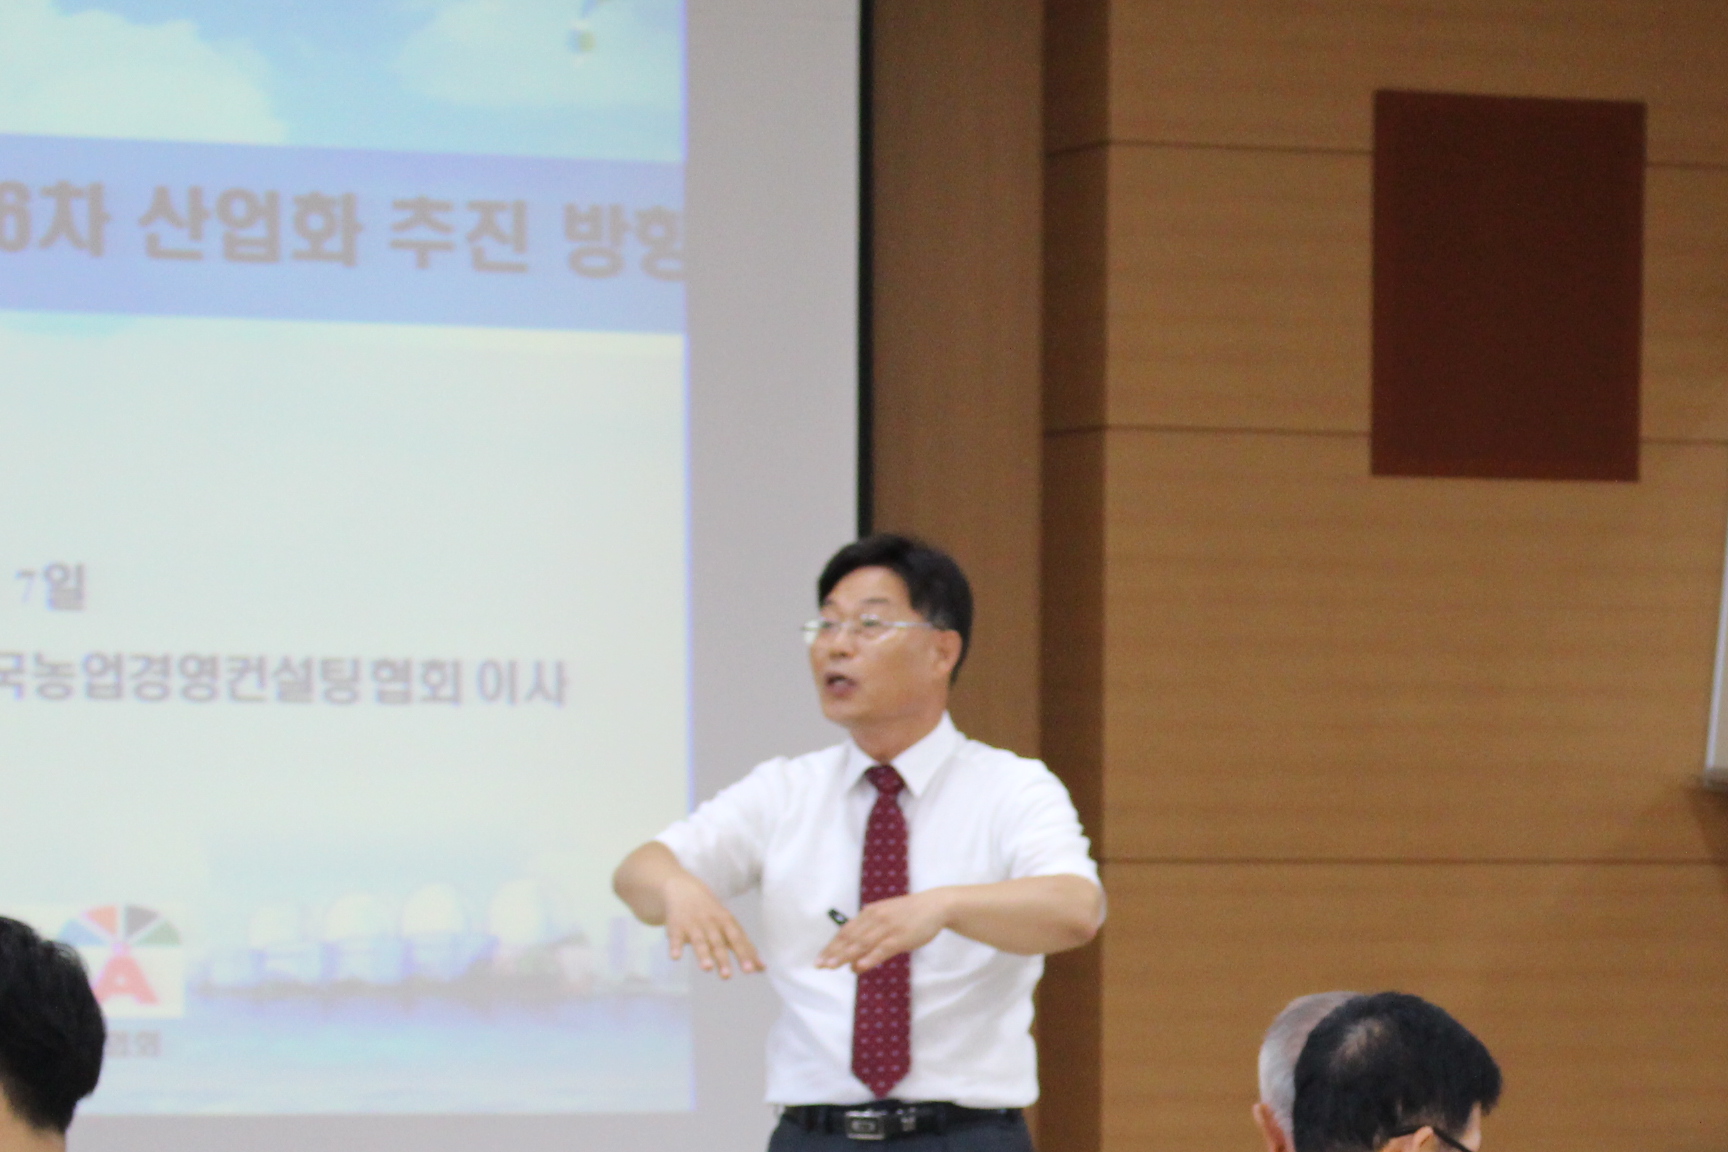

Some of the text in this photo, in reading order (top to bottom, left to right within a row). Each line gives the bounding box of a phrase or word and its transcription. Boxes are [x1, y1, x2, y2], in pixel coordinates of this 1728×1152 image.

[139, 184, 363, 267] 산업화
[390, 195, 529, 273] 추진
[475, 658, 570, 708] 이사
